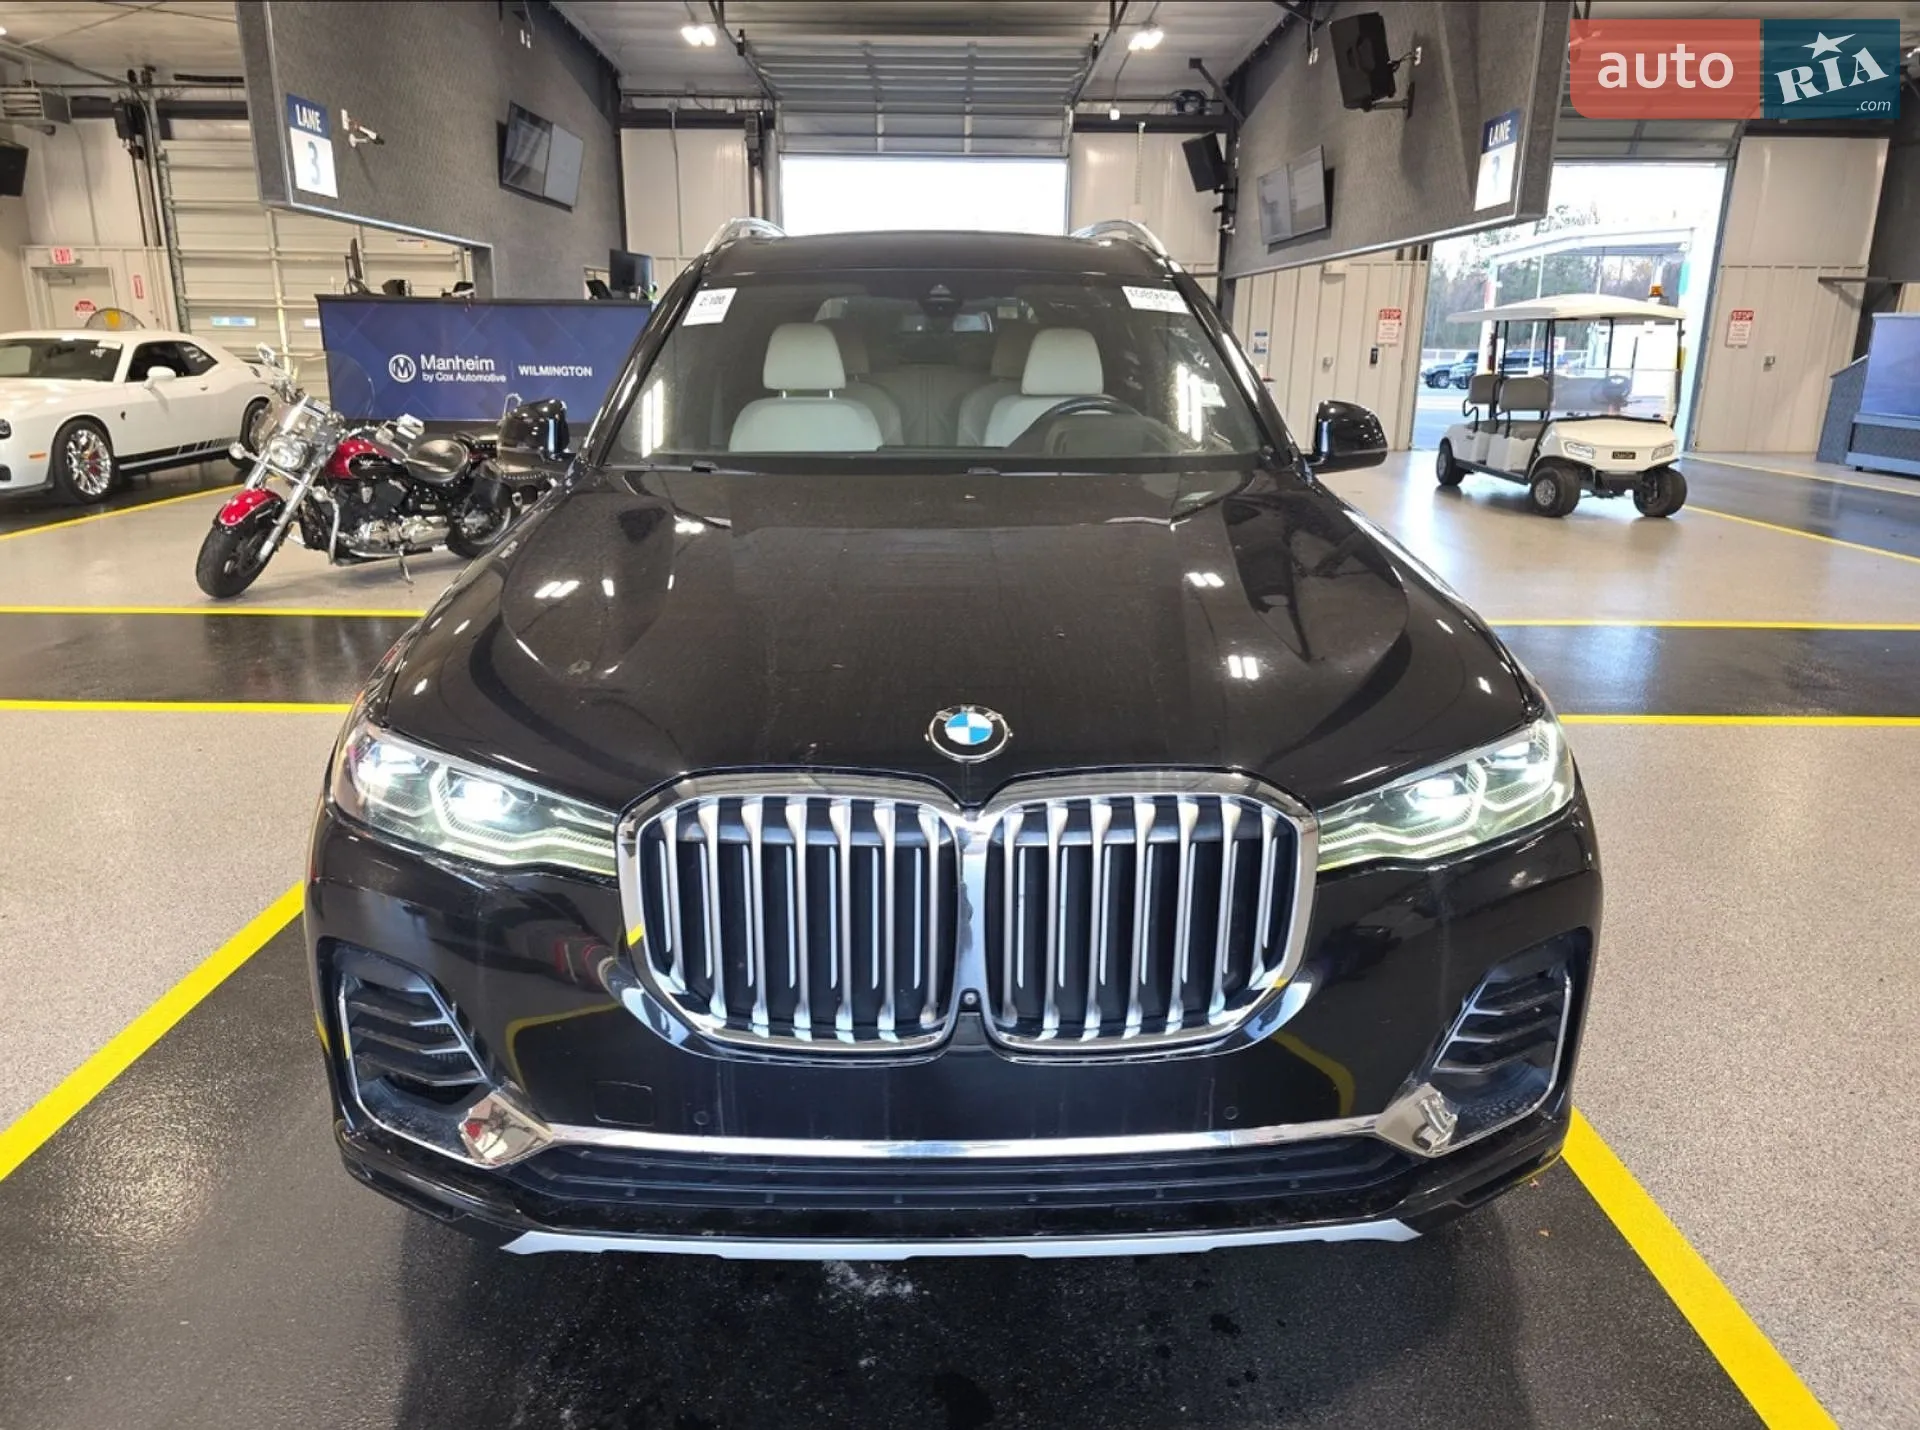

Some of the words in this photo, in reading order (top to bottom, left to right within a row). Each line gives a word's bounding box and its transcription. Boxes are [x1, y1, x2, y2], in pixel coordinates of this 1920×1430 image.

[295, 103, 322, 132] LANE
[1488, 119, 1512, 147] LANE
[307, 140, 321, 186] 3
[420, 354, 495, 371] Manheim
[518, 364, 593, 377] WILMINGTON
[422, 373, 433, 383] by
[435, 372, 454, 382] Cox
[455, 373, 507, 383] Automotive
